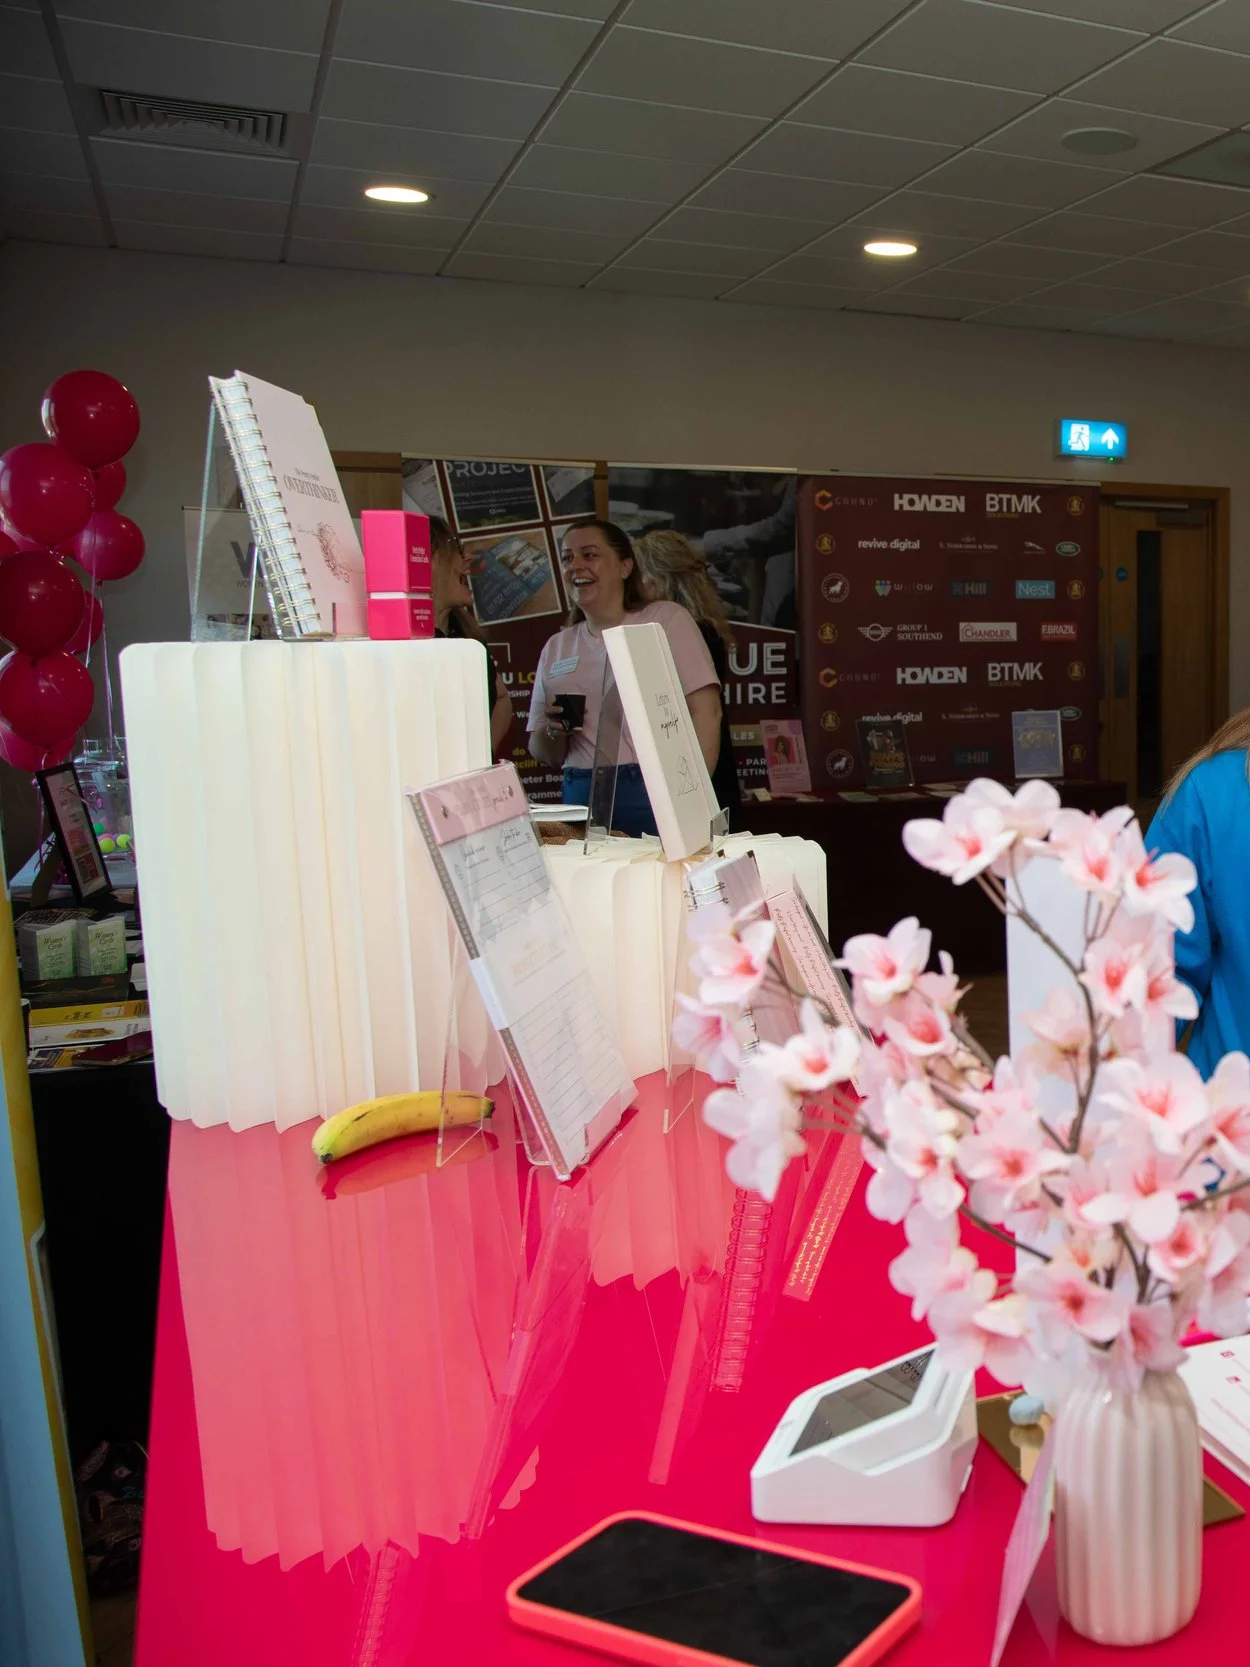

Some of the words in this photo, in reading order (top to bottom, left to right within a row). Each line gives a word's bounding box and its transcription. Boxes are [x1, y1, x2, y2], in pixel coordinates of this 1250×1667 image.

[446, 461, 525, 478] PROJEC
[283, 475, 340, 504] OVERTHINKER
[893, 493, 966, 512] HOWDEN
[985, 493, 1042, 514] BTMK
[858, 539, 888, 550] revive
[889, 539, 921, 552] digital
[1018, 583, 1051, 596] Nest
[897, 624, 923, 632] GROUP
[964, 627, 1011, 639] CHANDLER
[897, 632, 943, 641] SOUTHEND
[728, 642, 788, 676] UE
[896, 666, 968, 685] HOWDEN
[987, 661, 1044, 681] BTMK
[517, 671, 536, 685] LO
[510, 689, 531, 698] SHIP
[732, 731, 755, 741] LES
[512, 747, 527, 757] do
[514, 759, 539, 770] tcliff
[746, 758, 768, 767] PAR
[736, 768, 769, 777] EETIN
[545, 774, 564, 784] Boa
[527, 791, 563, 800] ramme
